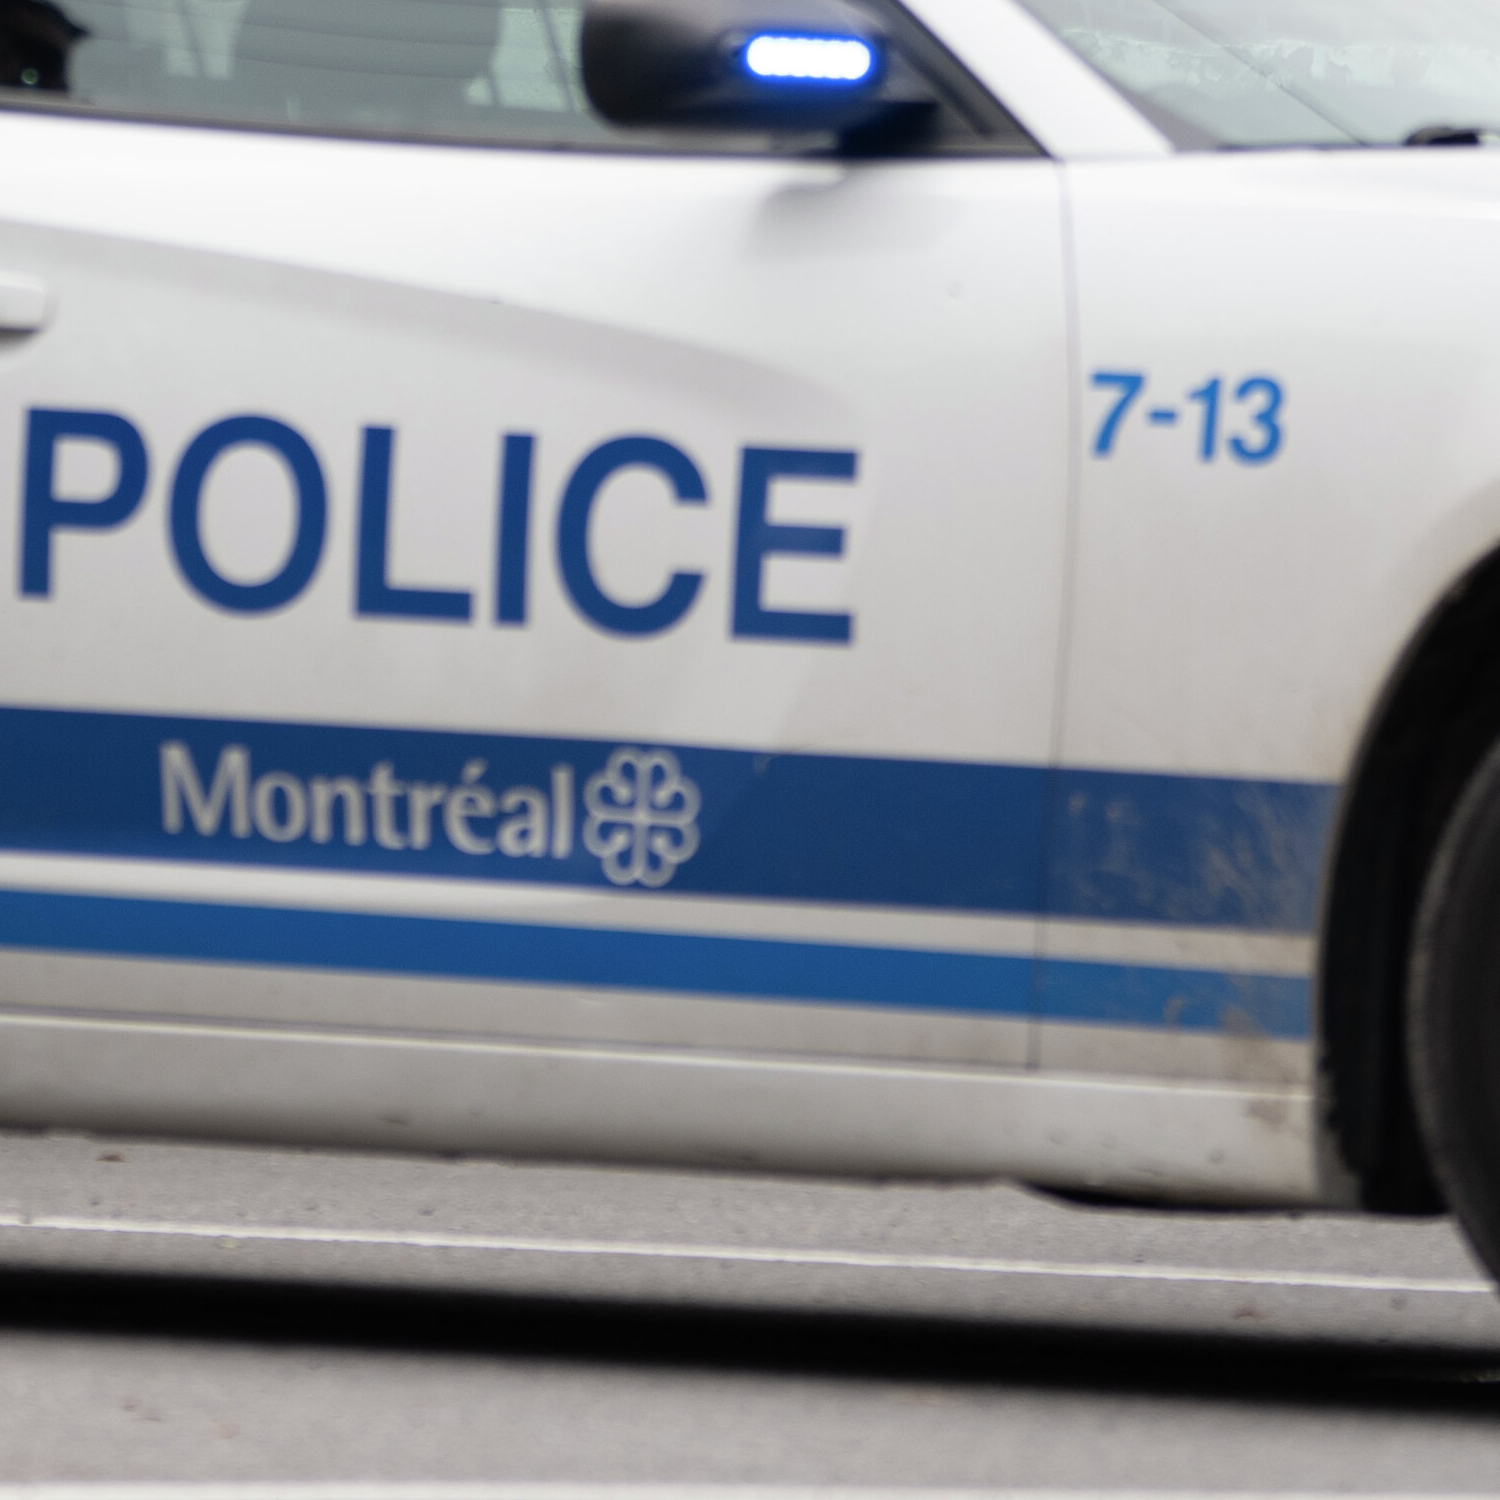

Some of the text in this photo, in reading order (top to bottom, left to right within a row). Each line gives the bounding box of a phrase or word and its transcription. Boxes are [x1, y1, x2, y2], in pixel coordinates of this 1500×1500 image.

[1090, 370, 1285, 467] 7-13
[17, 405, 862, 646] POLICE
[159, 740, 575, 861] Montréal
